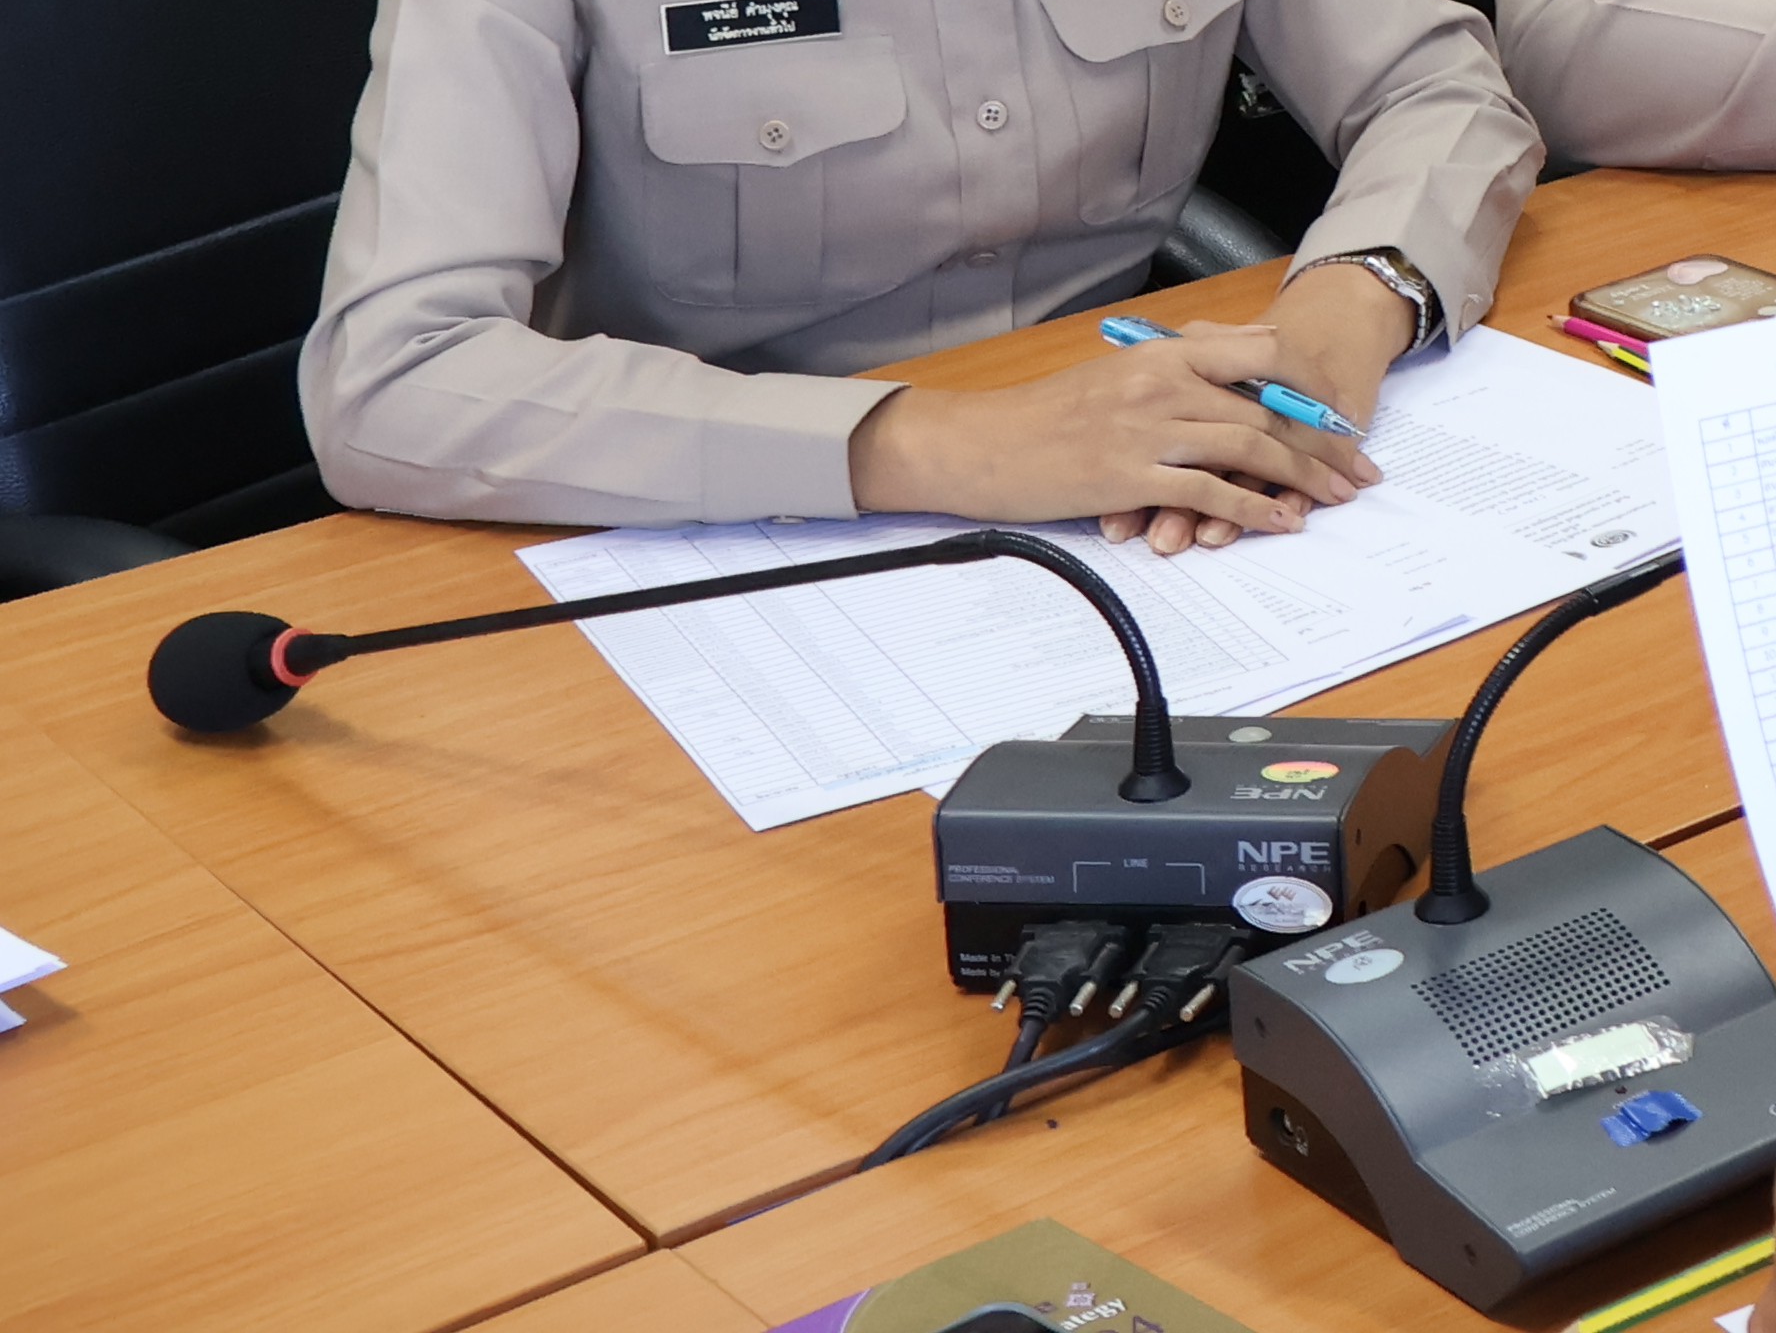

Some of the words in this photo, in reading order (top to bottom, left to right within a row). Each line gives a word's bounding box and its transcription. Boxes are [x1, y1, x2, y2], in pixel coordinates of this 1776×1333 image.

[1237, 840, 1331, 864] NPE
[1237, 864, 1331, 873] RESEARCH
[1284, 929, 1382, 973] NPE
